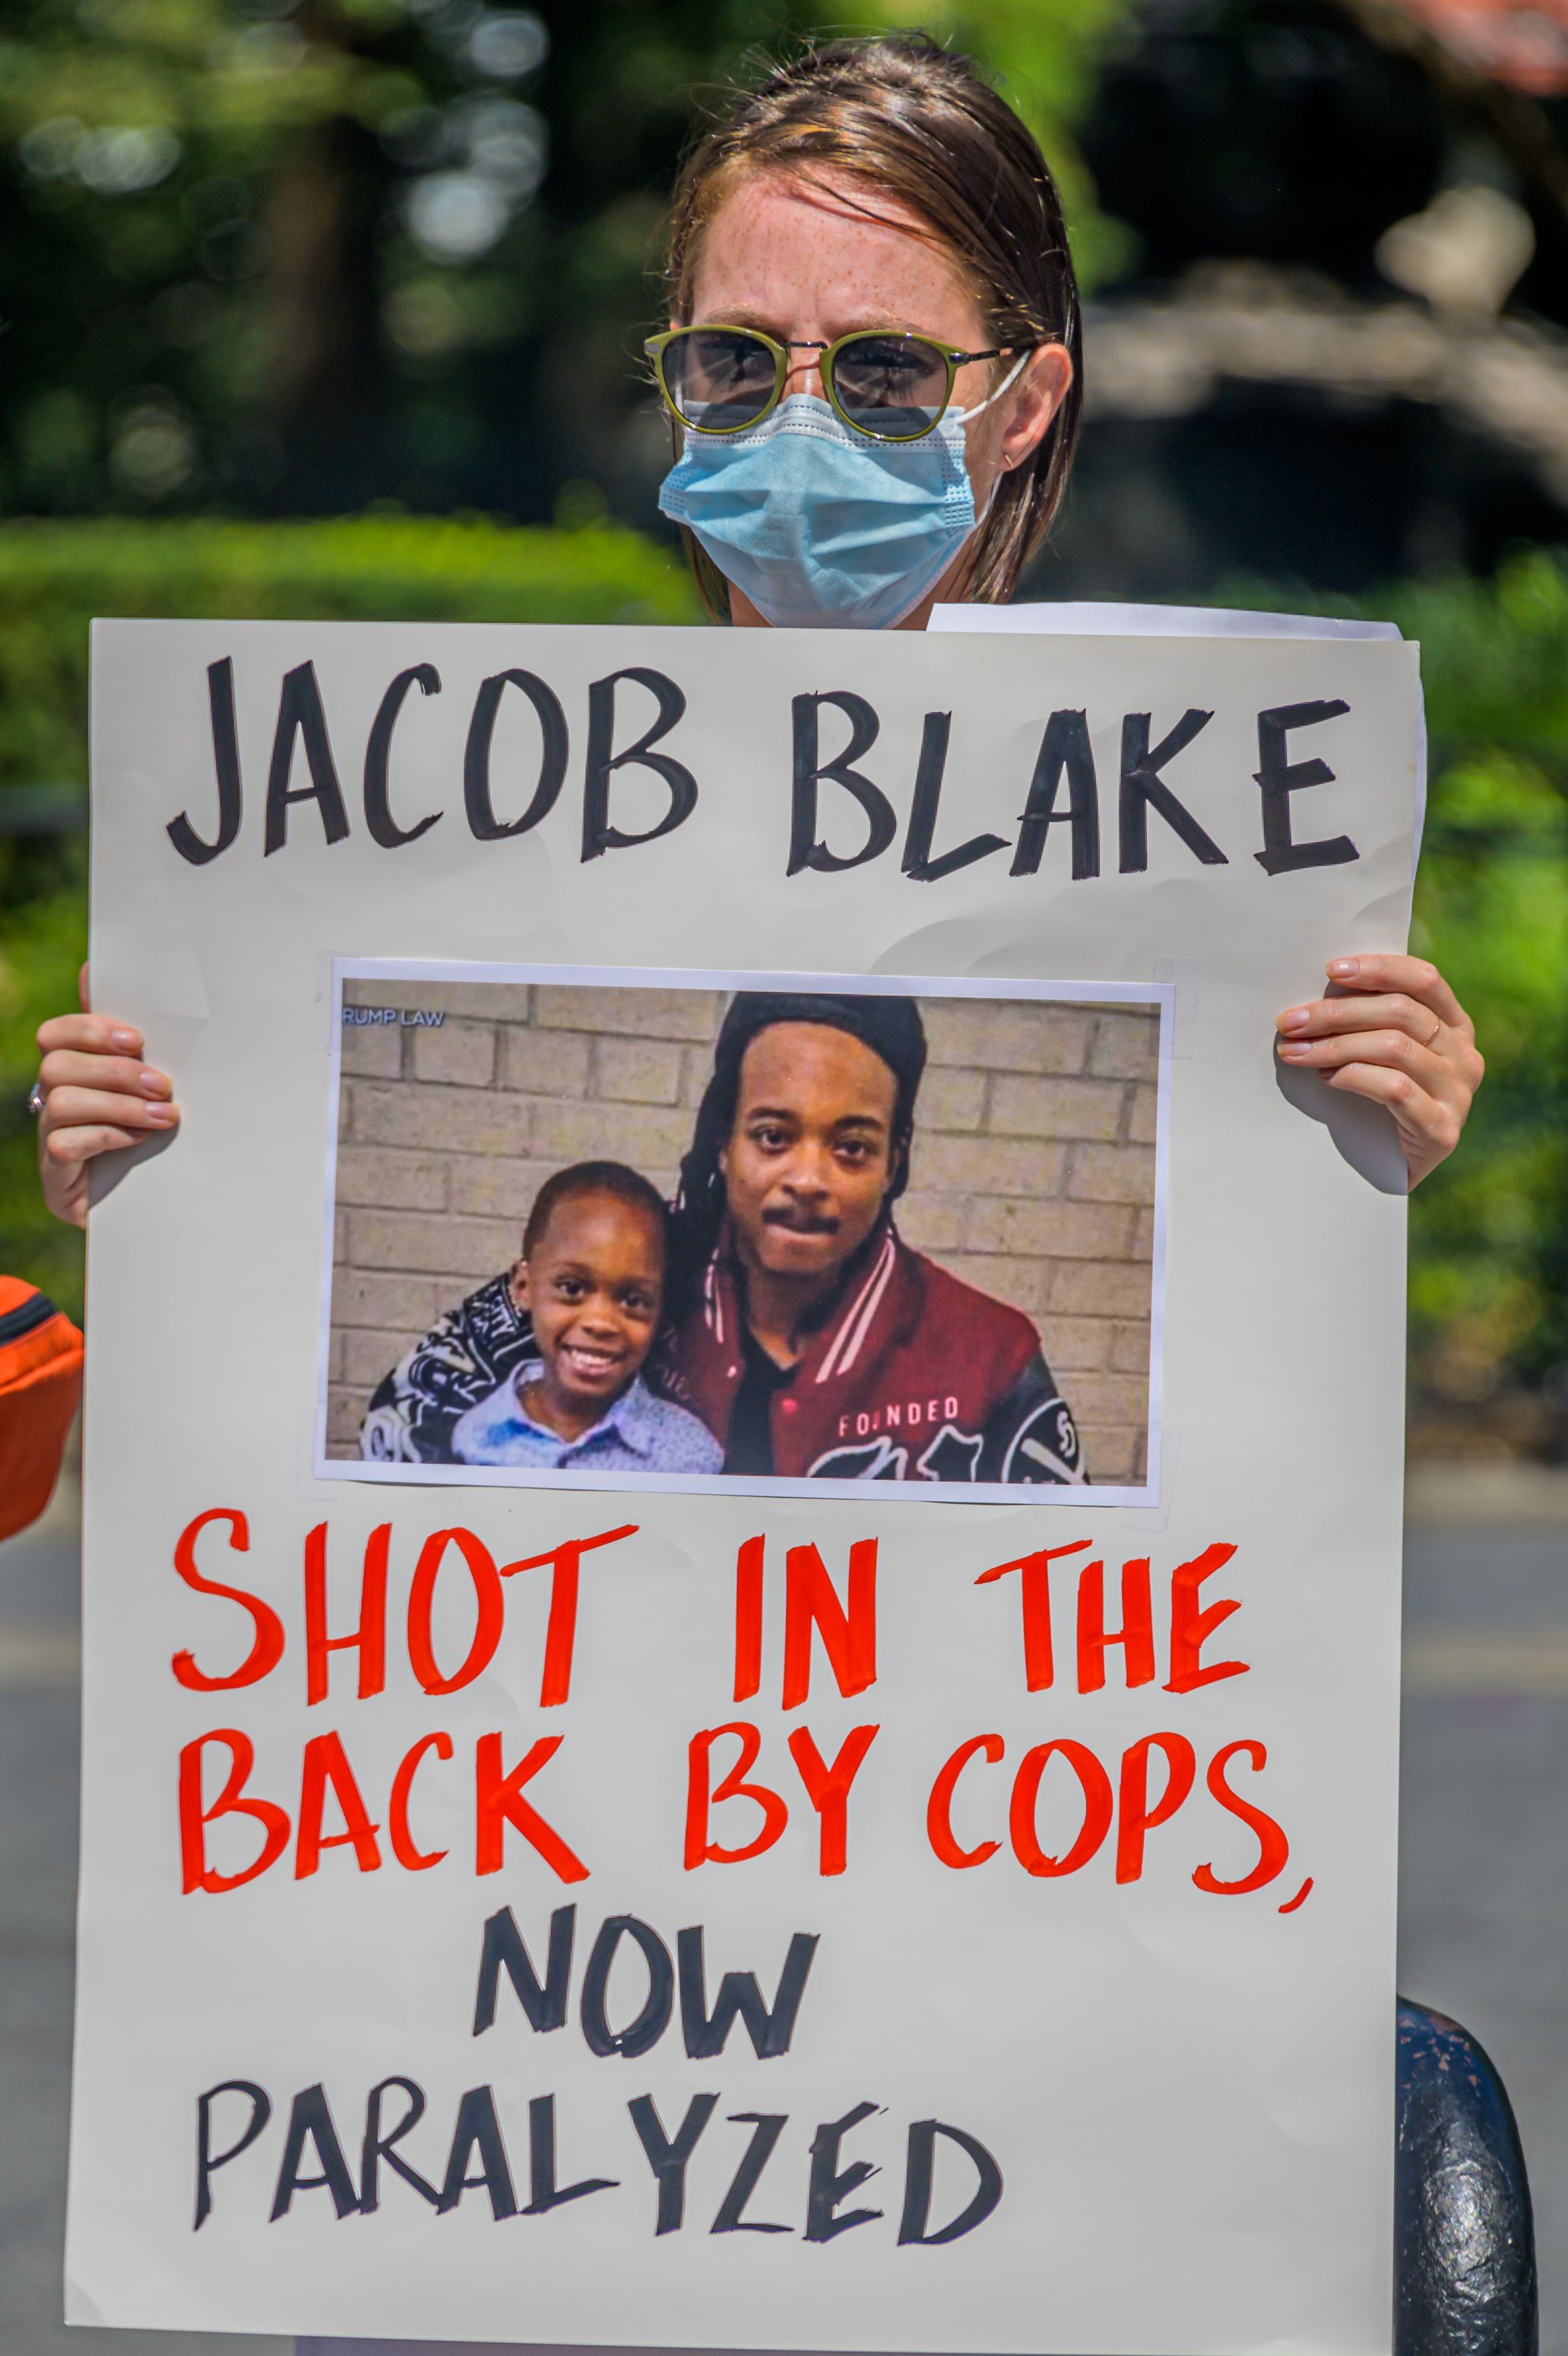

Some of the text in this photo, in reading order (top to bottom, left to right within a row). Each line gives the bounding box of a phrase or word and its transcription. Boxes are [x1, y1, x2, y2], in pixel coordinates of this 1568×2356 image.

[166, 655, 1361, 882] JACOB BLAKE
[343, 1007, 445, 1026] RUMP LAW
[172, 1508, 1251, 1711] SHOT IN THE
[179, 1721, 1315, 1914] BACK BY COPS,
[473, 1903, 821, 2060] NOW
[194, 2076, 1003, 2247] PARALYZED
